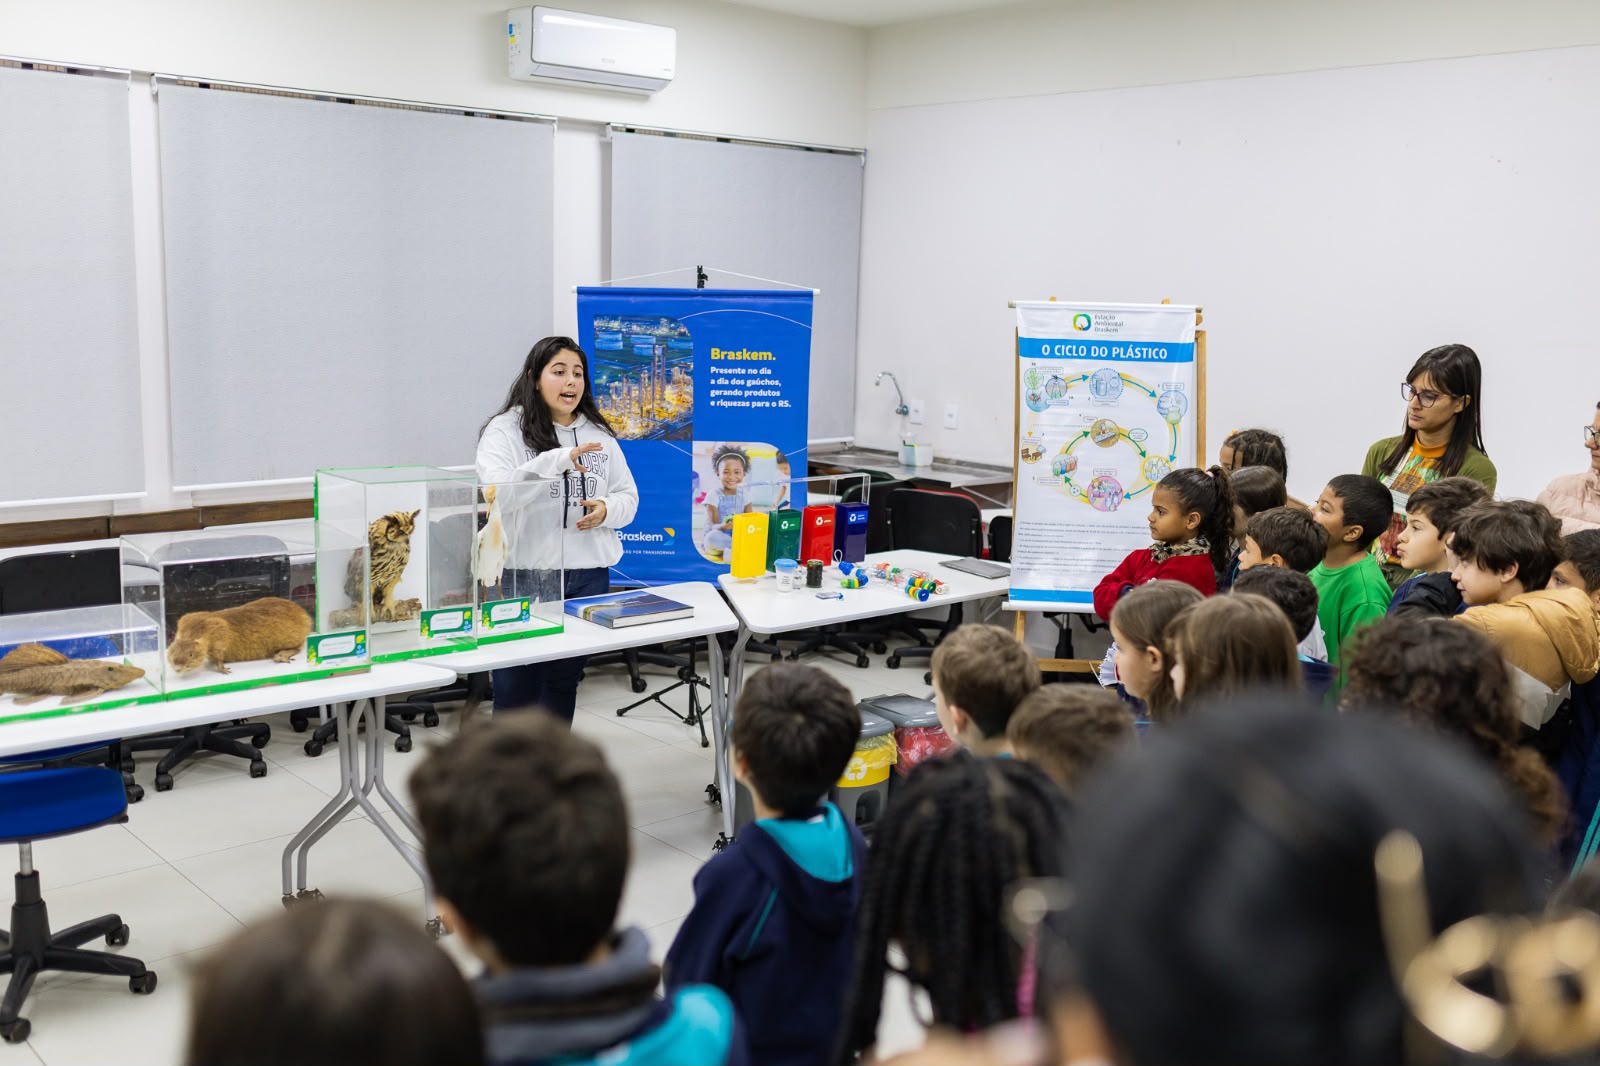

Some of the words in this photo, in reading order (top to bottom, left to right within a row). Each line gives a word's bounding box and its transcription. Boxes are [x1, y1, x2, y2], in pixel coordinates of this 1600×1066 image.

[710, 347, 777, 361] Braskem.
[1041, 344, 1050, 356] O
[1054, 344, 1087, 357] CICLO
[1090, 345, 1108, 358] DO
[1111, 344, 1168, 359] PLÁSTICO
[710, 366, 747, 375] Presente
[759, 367, 772, 375] dia
[717, 377, 729, 385] dia
[730, 377, 745, 385] dos
[746, 378, 782, 388] gaúchos,
[710, 389, 743, 398] gerando
[744, 389, 781, 398] produtos
[717, 399, 750, 408] riquezas
[778, 400, 792, 408] RS.
[550, 476, 598, 498] SOHO
[616, 530, 663, 542] Braskem
